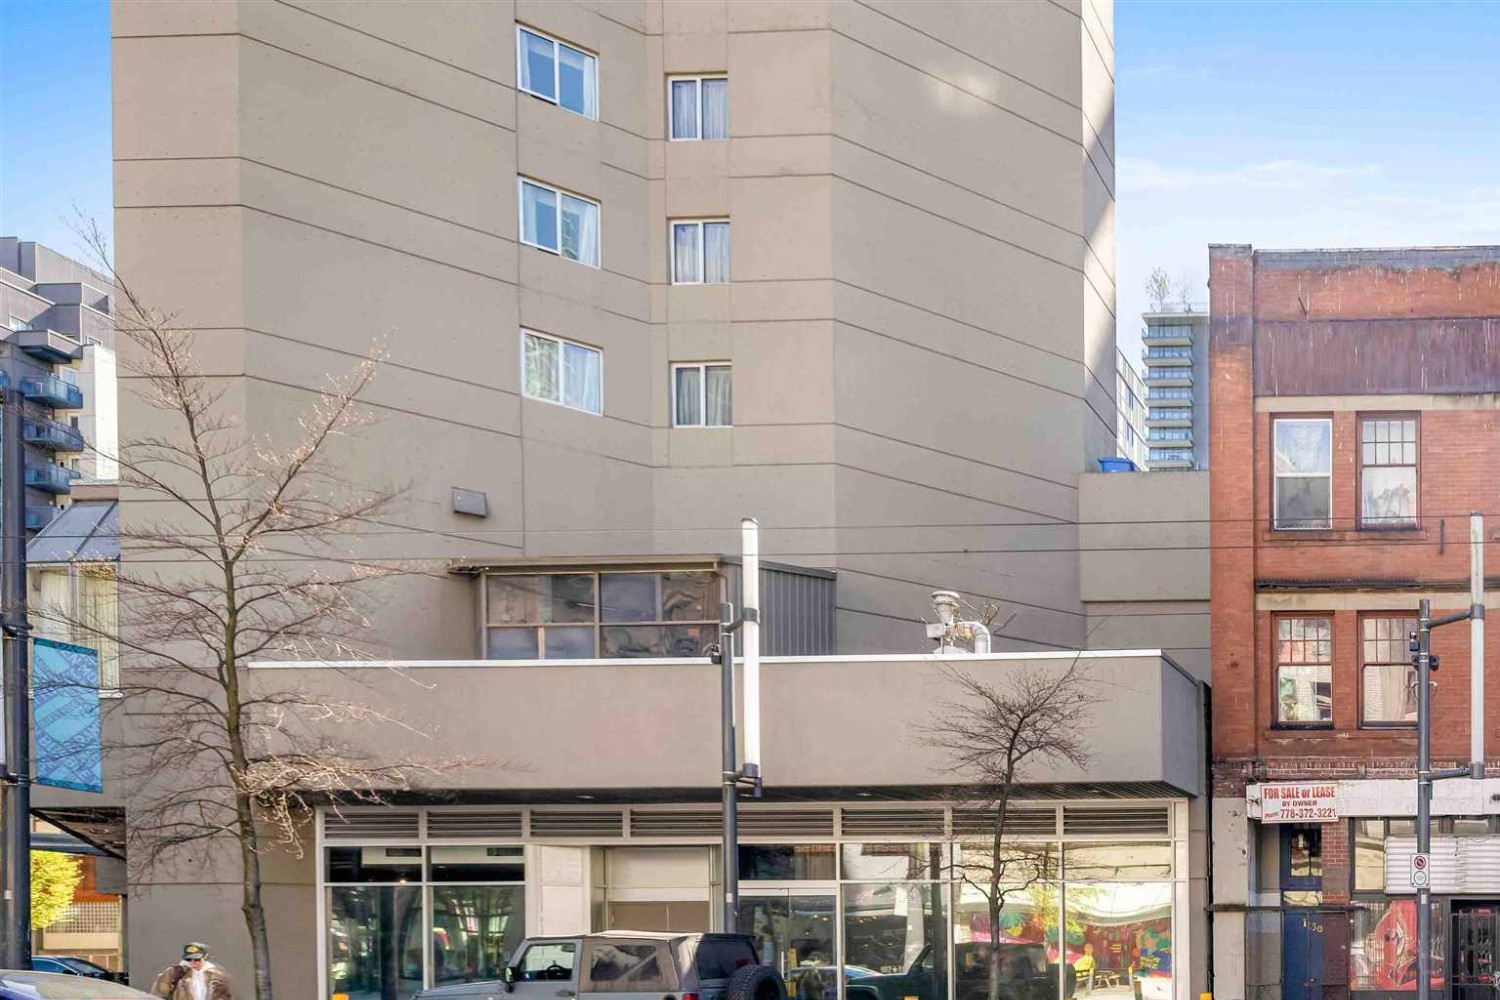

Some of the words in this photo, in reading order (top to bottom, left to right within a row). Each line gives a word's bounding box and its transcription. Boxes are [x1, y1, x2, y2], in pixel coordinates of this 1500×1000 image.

[1264, 788, 1279, 799] FOR
[1281, 787, 1300, 799] SALE
[1301, 788, 1311, 799] or
[1312, 786, 1336, 798] LEASE
[1280, 808, 1337, 819] 778-372-3221
